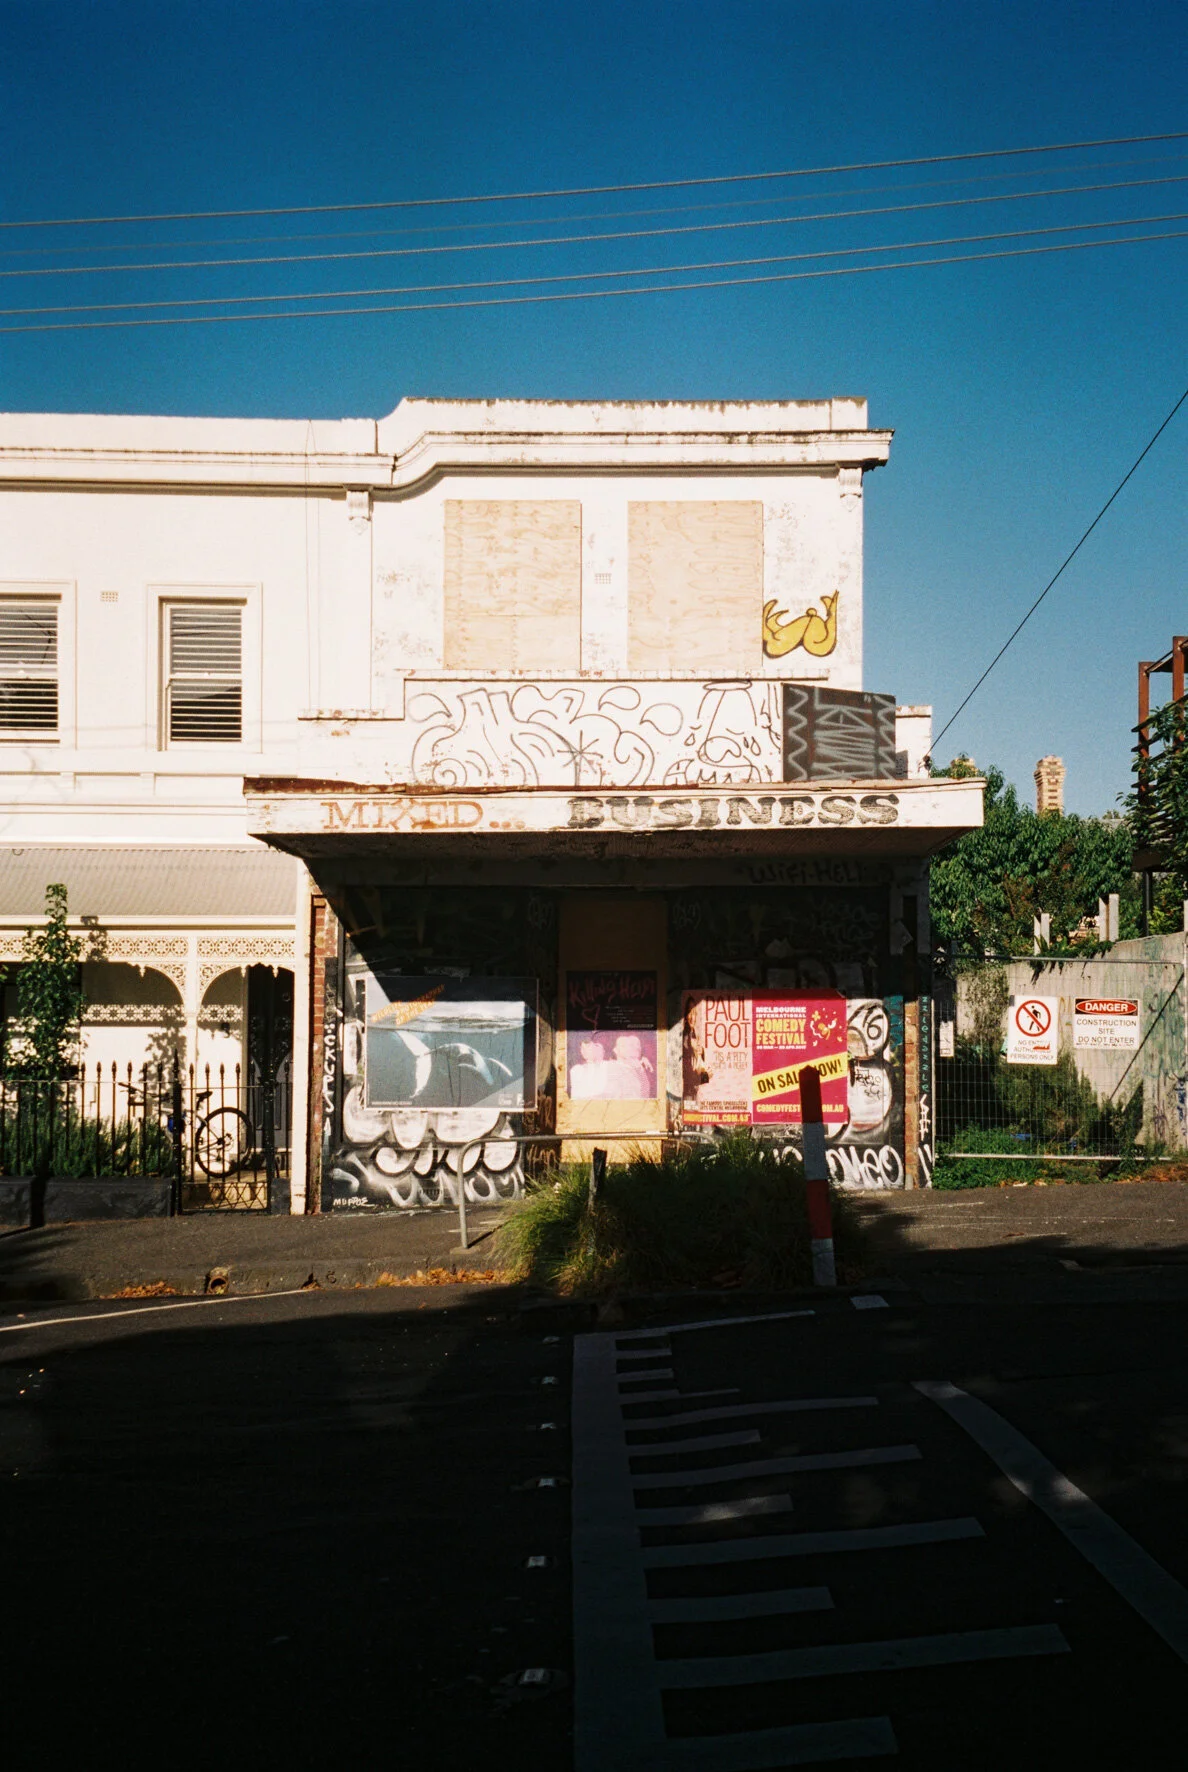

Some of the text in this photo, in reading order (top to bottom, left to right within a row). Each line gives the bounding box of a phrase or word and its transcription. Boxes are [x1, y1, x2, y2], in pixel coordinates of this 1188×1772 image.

[567, 794, 900, 828] BUSINESS
[704, 996, 749, 1022] PAUL
[1085, 1002, 1129, 1012] DANGER
[756, 1018, 806, 1033] COMEDY
[1076, 1018, 1137, 1027] CONSTRUCTION
[704, 1022, 751, 1048] FOOT
[1098, 1027, 1115, 1035] SITE
[756, 1032, 807, 1045] FESTIVAL
[1109, 1036, 1135, 1044] ENTER
[757, 1077, 776, 1094] ON
[777, 1070, 801, 1089] SAL
[756, 1103, 844, 1113] COMEDYFESTOM.AU
